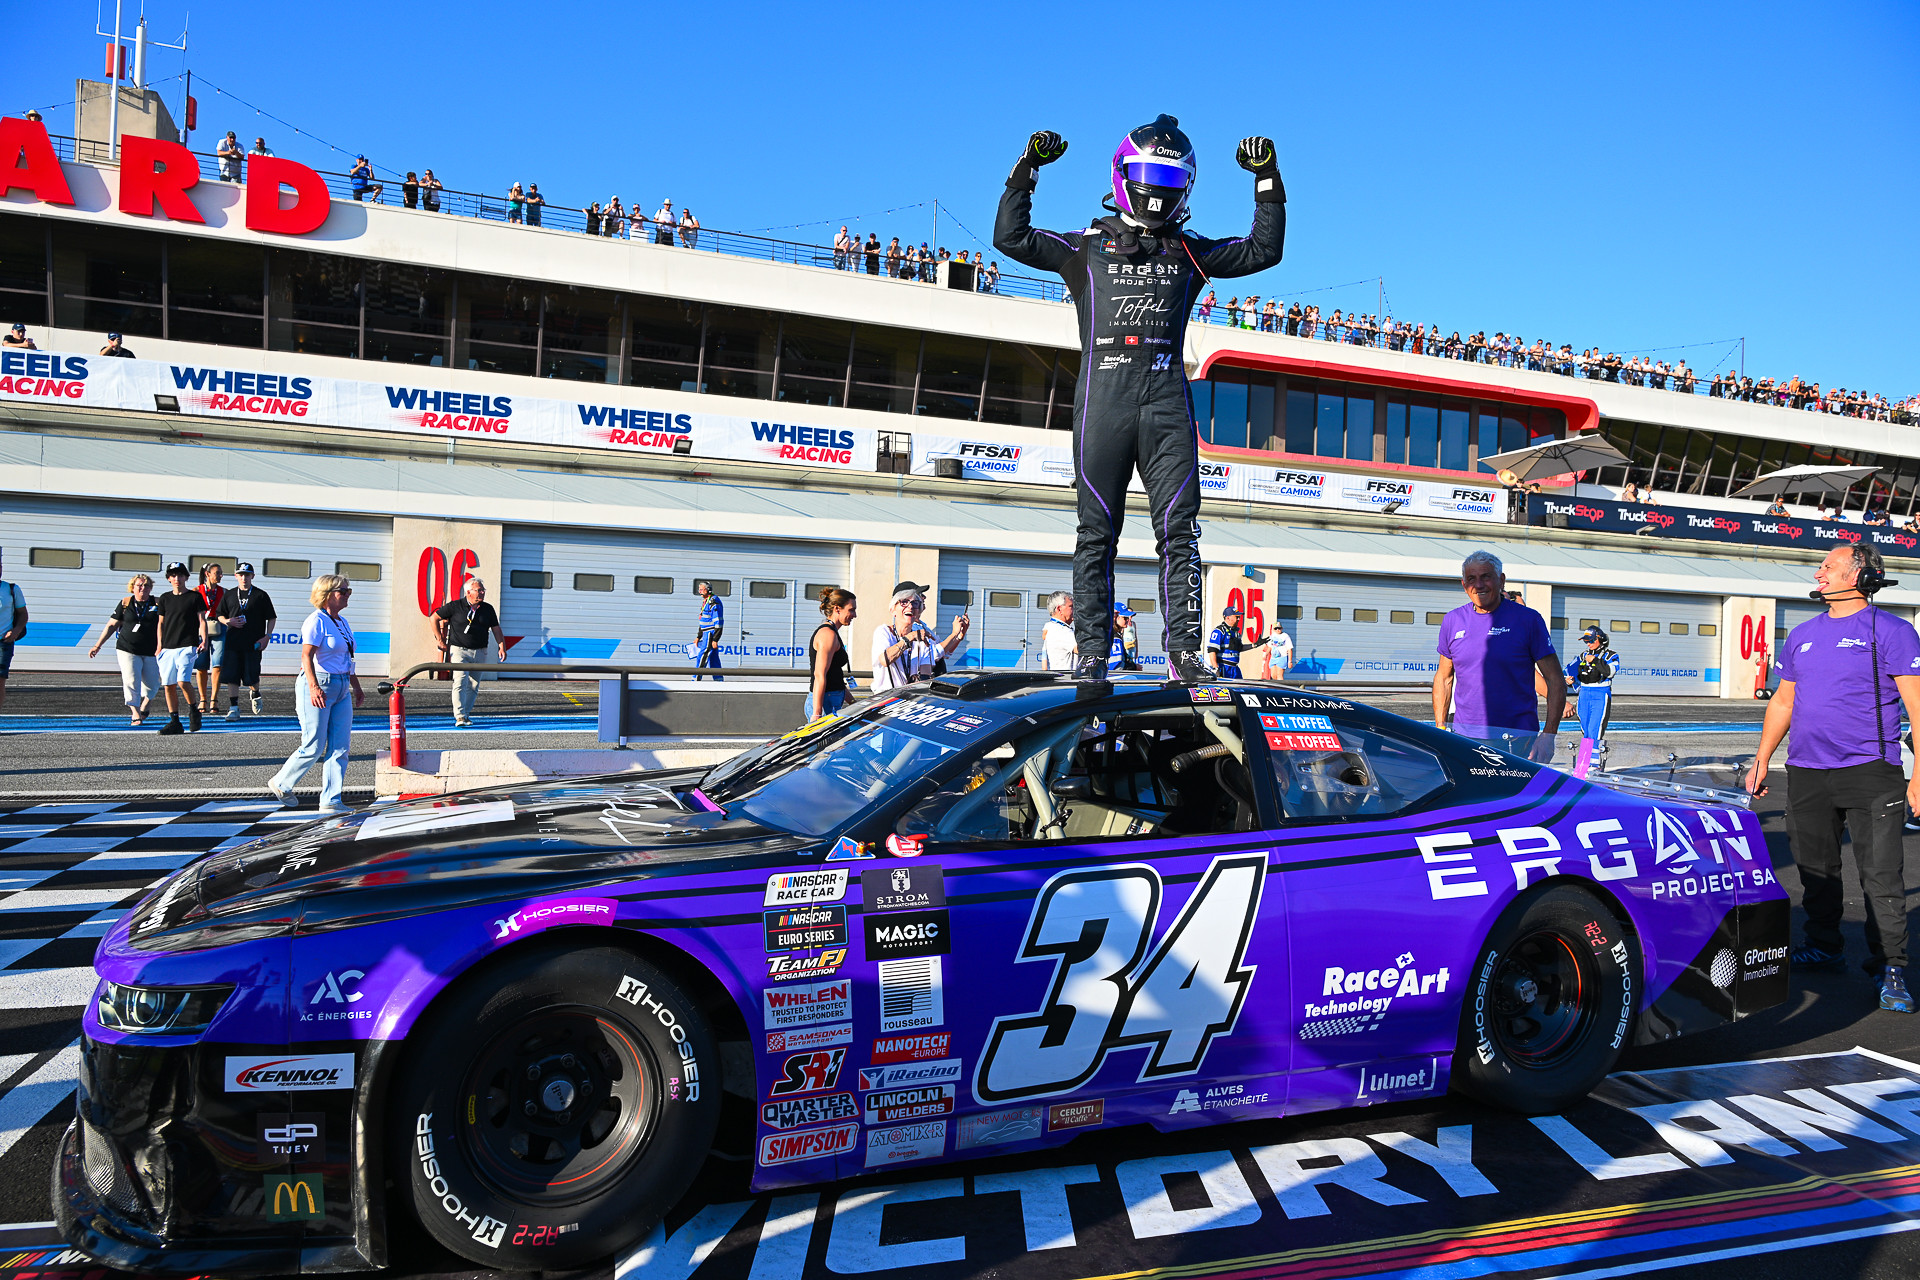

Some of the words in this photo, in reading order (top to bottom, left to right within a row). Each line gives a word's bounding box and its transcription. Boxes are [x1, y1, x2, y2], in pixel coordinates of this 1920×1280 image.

[1157, 146, 1182, 158] Omne
[1112, 278, 1158, 286] PROJECT
[1151, 353, 1173, 371] 34
[169, 365, 313, 400] WHEELS
[208, 392, 309, 418] RACING
[385, 385, 513, 418] WHEELS
[419, 411, 510, 435] RACING
[577, 404, 693, 434] WHEELS
[750, 421, 855, 450] WHEELS
[777, 443, 852, 465] RACING
[959, 443, 1014, 459] FFSA
[965, 460, 1017, 472] CAMIONS
[1275, 471, 1319, 486] FFSA
[1279, 486, 1322, 498] CAMIONS
[1366, 481, 1409, 495] FFSA
[1452, 489, 1491, 503] FFSA
[1456, 503, 1493, 514] CAMIONS
[1617, 508, 1675, 529] TruckStop
[1687, 514, 1741, 534] TruckStop
[1752, 520, 1803, 540] TruckStop
[1872, 532, 1917, 549] TruckStop
[1227, 587, 1264, 643] 05
[1740, 614, 1767, 660] 04
[755, 646, 805, 657] RICARD
[1134, 655, 1166, 665] ICARD
[1354, 661, 1400, 671] CIRCUIT
[1403, 662, 1426, 671] PAUL
[1651, 668, 1670, 677] PAUL
[1671, 669, 1698, 677] RICARD
[1266, 696, 1355, 711] ALFAGAMME
[1276, 715, 1289, 729] T.
[1288, 716, 1332, 729] TOFFEL
[1284, 735, 1297, 748] T.
[1296, 735, 1341, 748] TOFFEL
[1469, 767, 1498, 778] starjet
[1498, 769, 1532, 779] aviation
[791, 873, 838, 889] NASCAR
[1651, 871, 1746, 900] PROJECT
[1751, 867, 1776, 887] SA
[777, 889, 807, 900] RACE
[810, 887, 835, 897] CAR
[876, 892, 929, 905] STROM
[522, 904, 610, 921] HOOSIER
[790, 910, 833, 926] NASCAR
[778, 933, 803, 946] EURO
[803, 929, 835, 943] SERIES
[882, 940, 934, 949] MOTORSPORT
[1744, 946, 1788, 966] GPartner
[774, 967, 836, 981] ORGANIZATION
[971, 851, 1270, 1107] 34
[1743, 964, 1780, 981] Immobilier
[766, 983, 848, 1008] WHELEN
[1475, 950, 1499, 1044] HOOSIER
[771, 1007, 804, 1017] TRUSTED
[816, 1001, 848, 1011] PROTECT
[1304, 996, 1393, 1018] Technology
[1610, 961, 1631, 1050] HOOSIER
[299, 1013, 314, 1022] AC
[317, 1010, 373, 1021] ÉNERGIES
[776, 1014, 797, 1025] FIRST
[798, 1010, 845, 1022] RESPONDERS
[884, 1016, 933, 1030] rousseau
[787, 1037, 835, 1047] MOTORSPORT
[788, 1027, 852, 1042] SAMSONAS
[640, 992, 700, 1103] HOOSIER
[875, 1034, 949, 1054] NANOTECH
[242, 1068, 341, 1083] KENNOL
[770, 1048, 848, 1095] SRI
[886, 1065, 961, 1084] iRacing
[870, 1088, 940, 1108] LINCOLN
[1206, 1084, 1244, 1098] ALVES
[763, 1093, 850, 1122] QUARTER
[885, 1103, 946, 1119] WELDERS
[1060, 1105, 1095, 1117] CERUTTI
[779, 1105, 855, 1128] MASTER
[976, 1115, 1000, 1126] NEW
[272, 1144, 310, 1154] TIJEY
[767, 1128, 851, 1161] SIMPSON
[416, 1112, 480, 1231] HOOSIER
